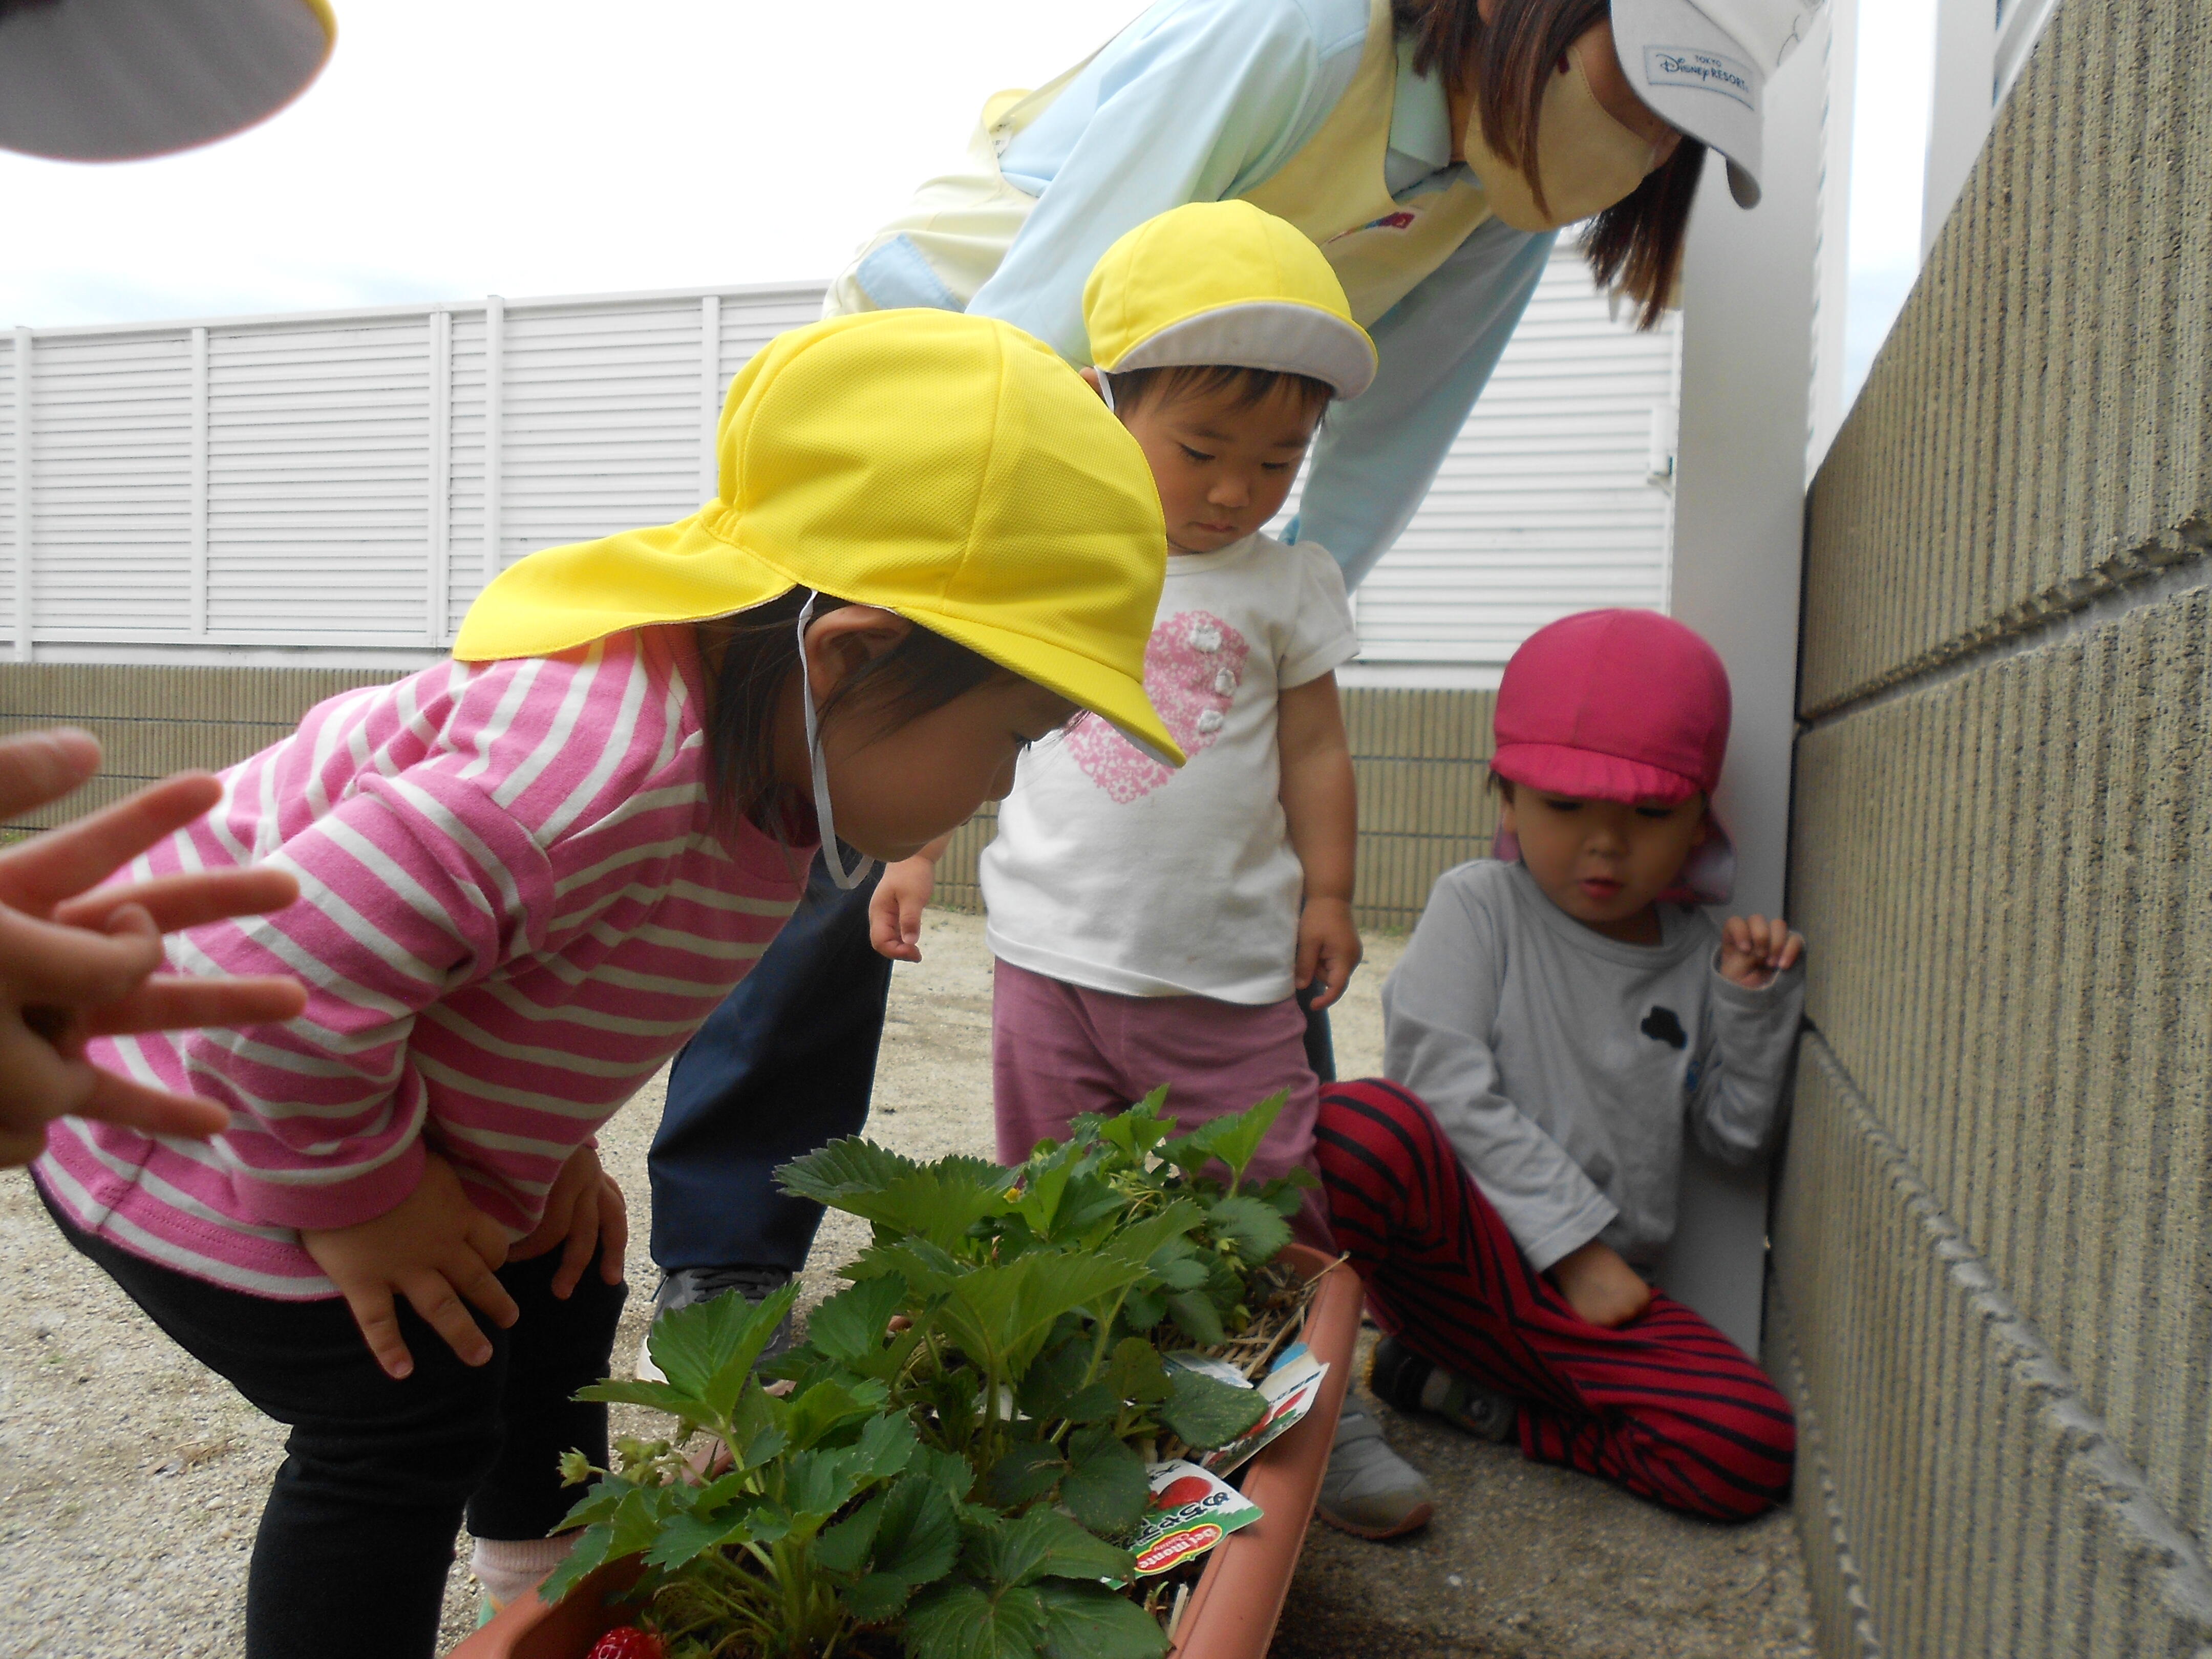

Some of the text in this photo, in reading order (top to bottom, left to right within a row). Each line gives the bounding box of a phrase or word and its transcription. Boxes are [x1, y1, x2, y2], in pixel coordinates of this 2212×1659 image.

[1695, 55, 1721, 67] TOKYO
[1138, 1528, 1217, 1569] Del Monte
